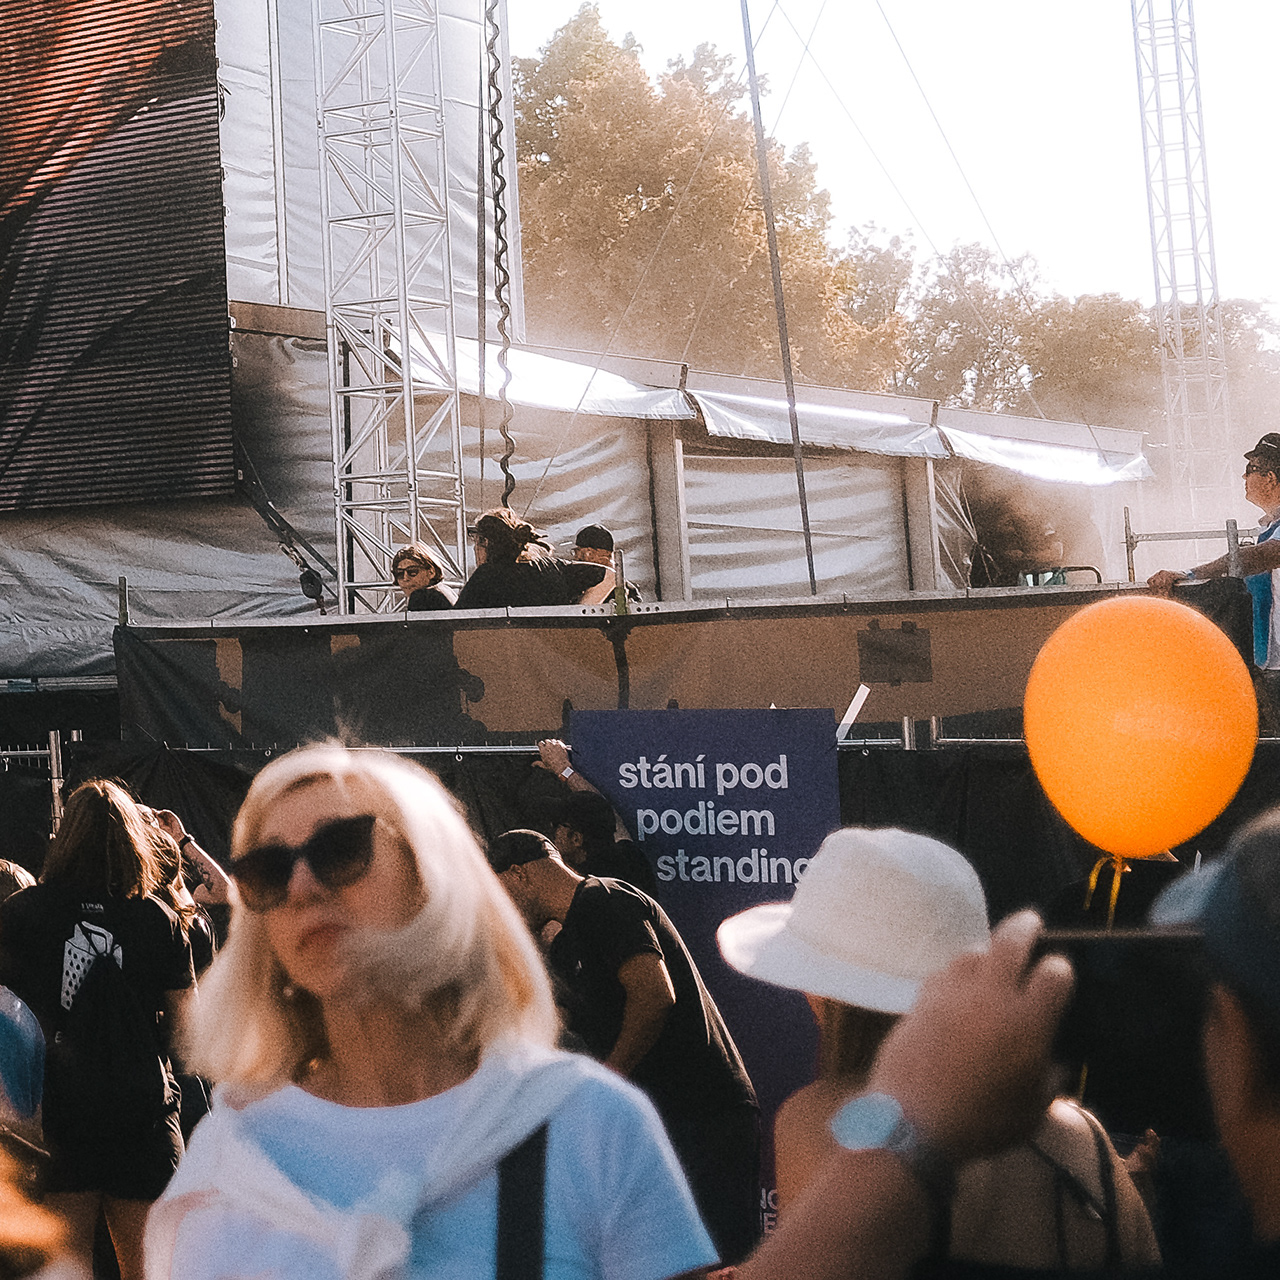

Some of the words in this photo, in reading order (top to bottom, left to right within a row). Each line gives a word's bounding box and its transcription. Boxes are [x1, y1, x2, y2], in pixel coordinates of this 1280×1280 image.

[618, 754, 706, 788] stání
[716, 754, 789, 795] pod
[636, 801, 775, 841] podiem
